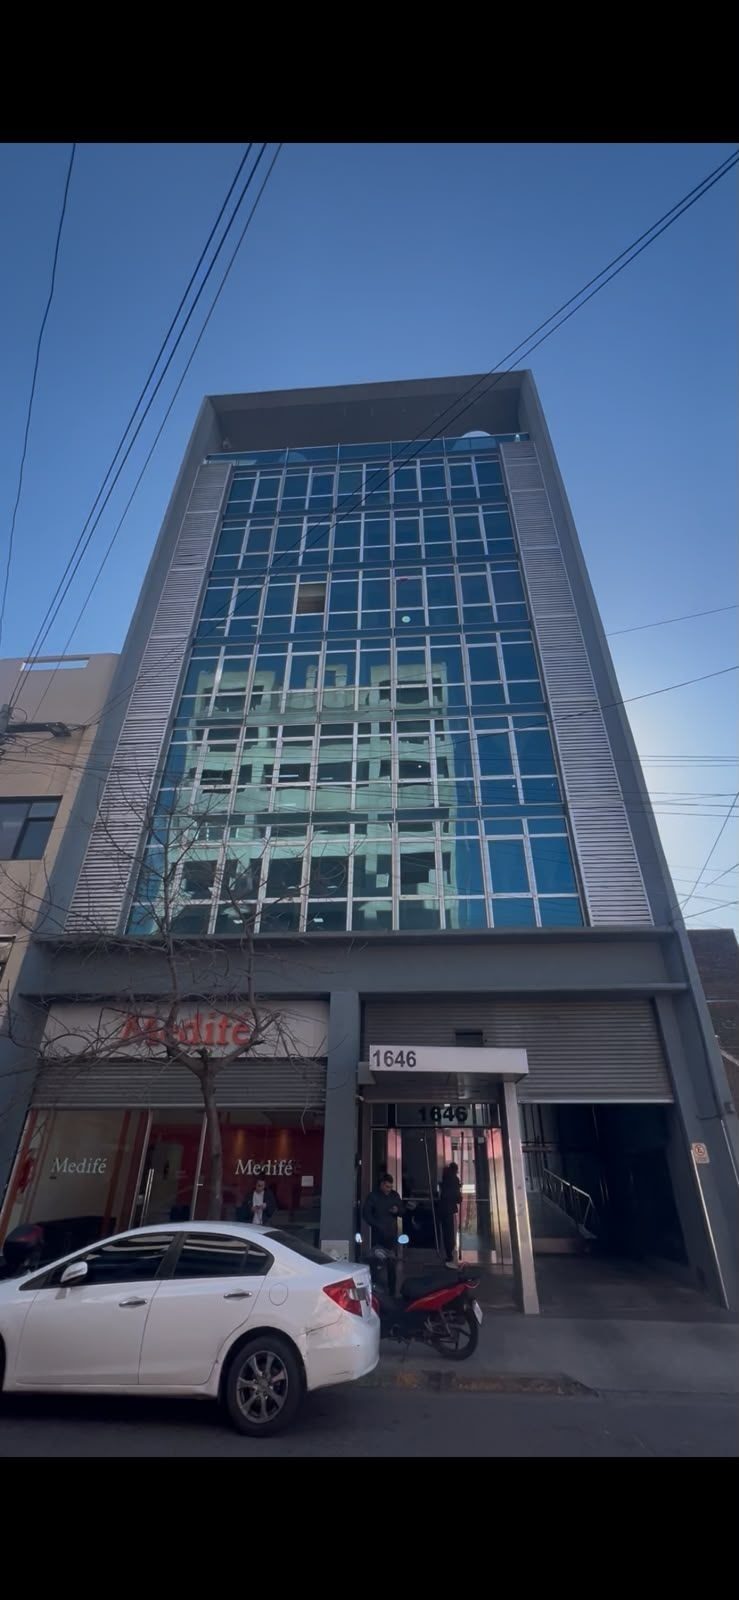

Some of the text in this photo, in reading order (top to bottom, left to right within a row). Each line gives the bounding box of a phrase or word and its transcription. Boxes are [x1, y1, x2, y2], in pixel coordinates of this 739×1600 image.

[372, 1049, 417, 1068] 1646
[418, 1105, 468, 1123] 1646
[51, 1157, 107, 1174] Medifé
[235, 1159, 293, 1176] Medifé
